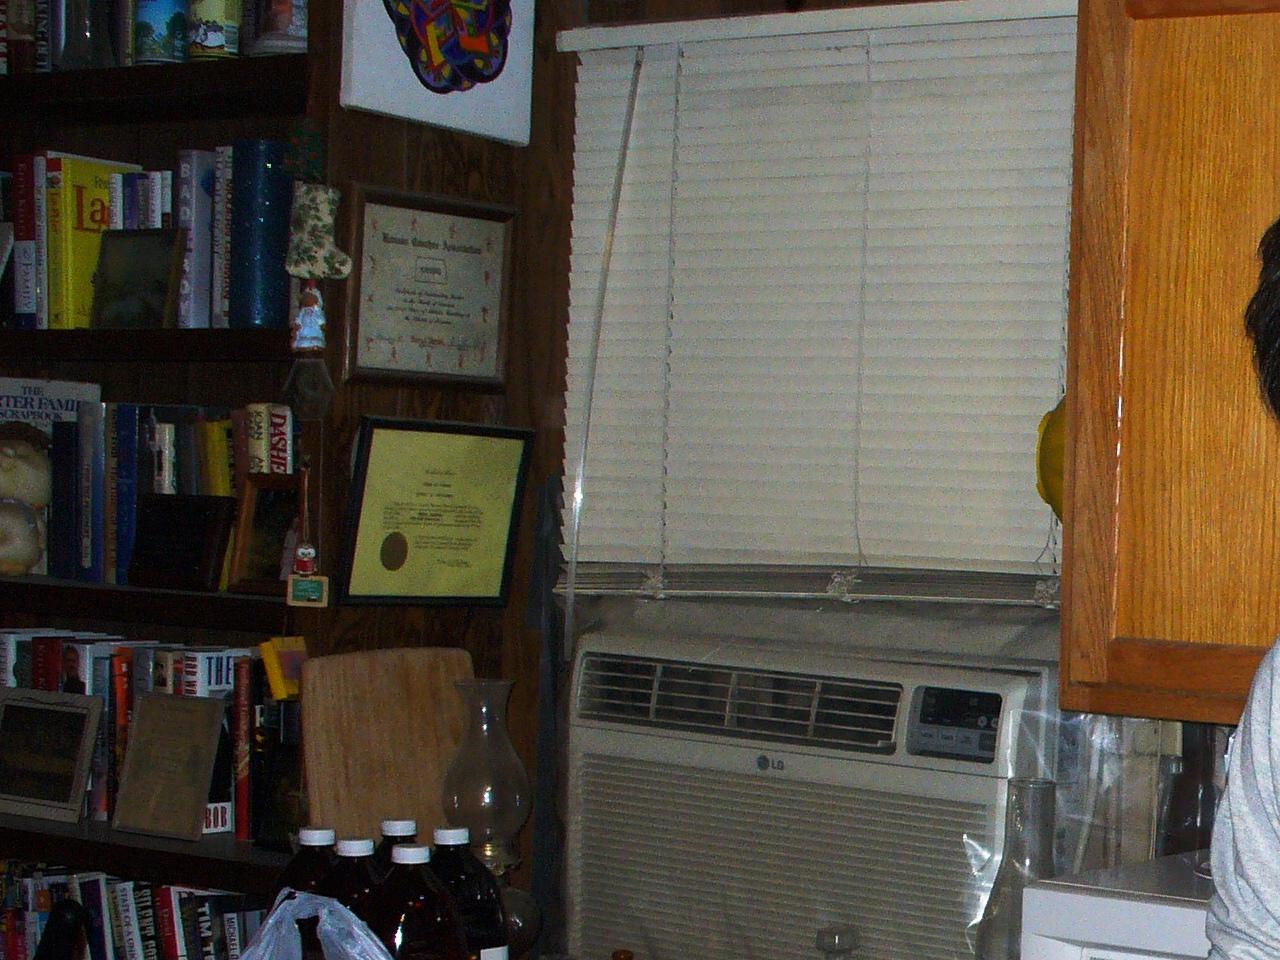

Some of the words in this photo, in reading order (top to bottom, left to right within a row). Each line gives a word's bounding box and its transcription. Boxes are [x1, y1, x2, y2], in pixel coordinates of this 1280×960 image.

[21, 386, 44, 396] THE
[206, 656, 232, 686] THE
[771, 760, 785, 770] LG
[205, 806, 228, 829] BOB
[197, 902, 213, 938] TIM
